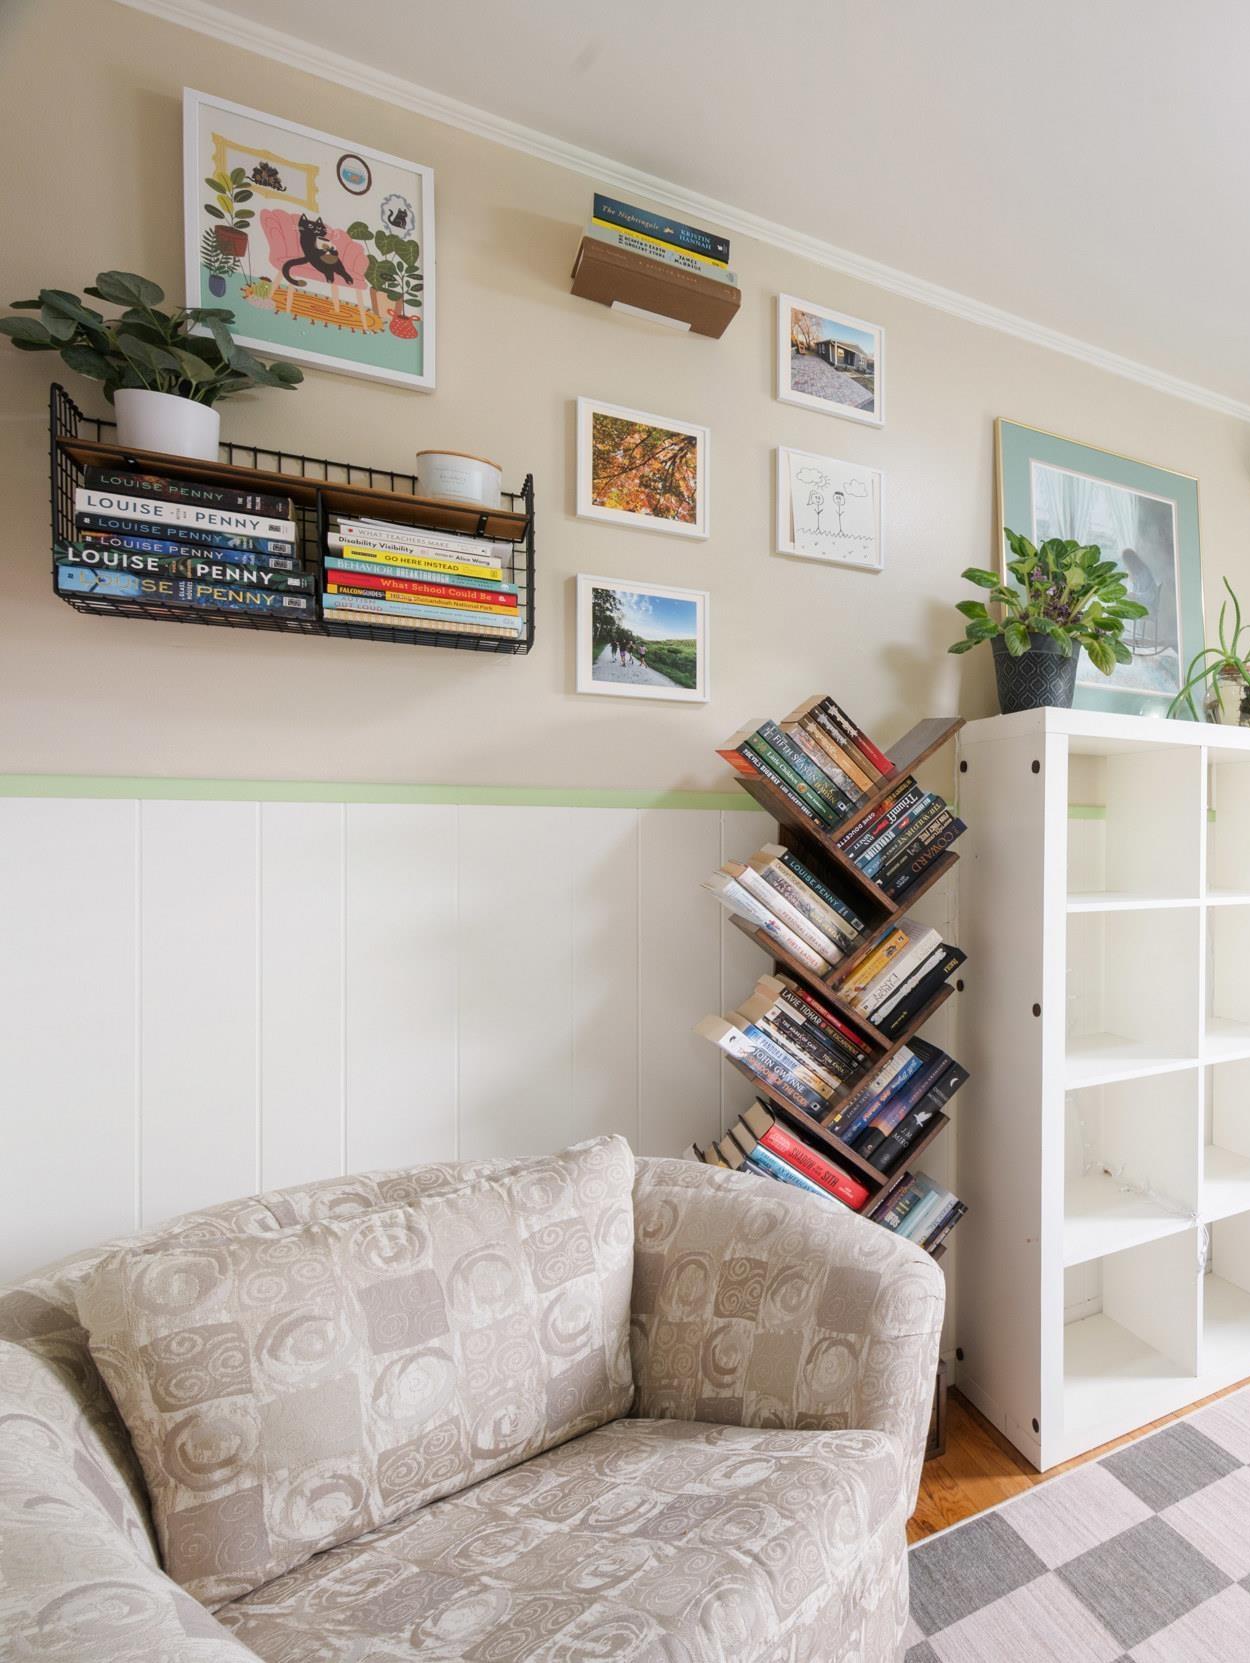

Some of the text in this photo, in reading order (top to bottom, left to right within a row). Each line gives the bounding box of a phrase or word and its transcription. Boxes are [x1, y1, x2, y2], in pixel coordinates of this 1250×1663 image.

[601, 204, 660, 231] The Nightingale
[679, 235, 712, 250] HANNAH
[680, 228, 711, 243] KRISTIN
[101, 475, 224, 501] LOUISE PENNY
[87, 495, 260, 530] LOUISE PENNY
[98, 518, 161, 535] LOUISE
[167, 528, 222, 544] PENNY
[358, 528, 383, 538] WHAT
[386, 531, 426, 545] TEACHERS
[101, 537, 162, 553] LOUISE
[169, 546, 224, 560] PENNY
[338, 536, 414, 554] Disability Visibility
[67, 547, 159, 572] LOUISE
[196, 564, 273, 585] PENNY
[337, 559, 393, 577] BEHAVIOR
[400, 557, 422, 566] HERE
[424, 560, 459, 571] INSTEAD
[456, 554, 471, 562] Alice
[472, 557, 490, 567] Wong
[80, 570, 275, 606] LOUISE PENNY
[380, 578, 492, 601] What School Could Be
[766, 751, 798, 783] Little Children
[773, 735, 818, 780] FIFTH SEASON
[885, 792, 918, 823] Triumff
[837, 812, 875, 847] GENE DOUCETTE
[909, 831, 954, 872] COWARD
[789, 861, 815, 885] LOUISE
[815, 884, 839, 907] PENNY
[781, 990, 800, 1007] LAVIE
[800, 1005, 821, 1024] TIDHAR
[781, 1019, 789, 1027] THE
[806, 1040, 817, 1050] CAIN
[753, 1048, 804, 1093] JOHN GWYNNE
[781, 1083, 794, 1095] THE
[789, 1147, 816, 1169] SHADOW
[820, 1170, 839, 1187] SITH
